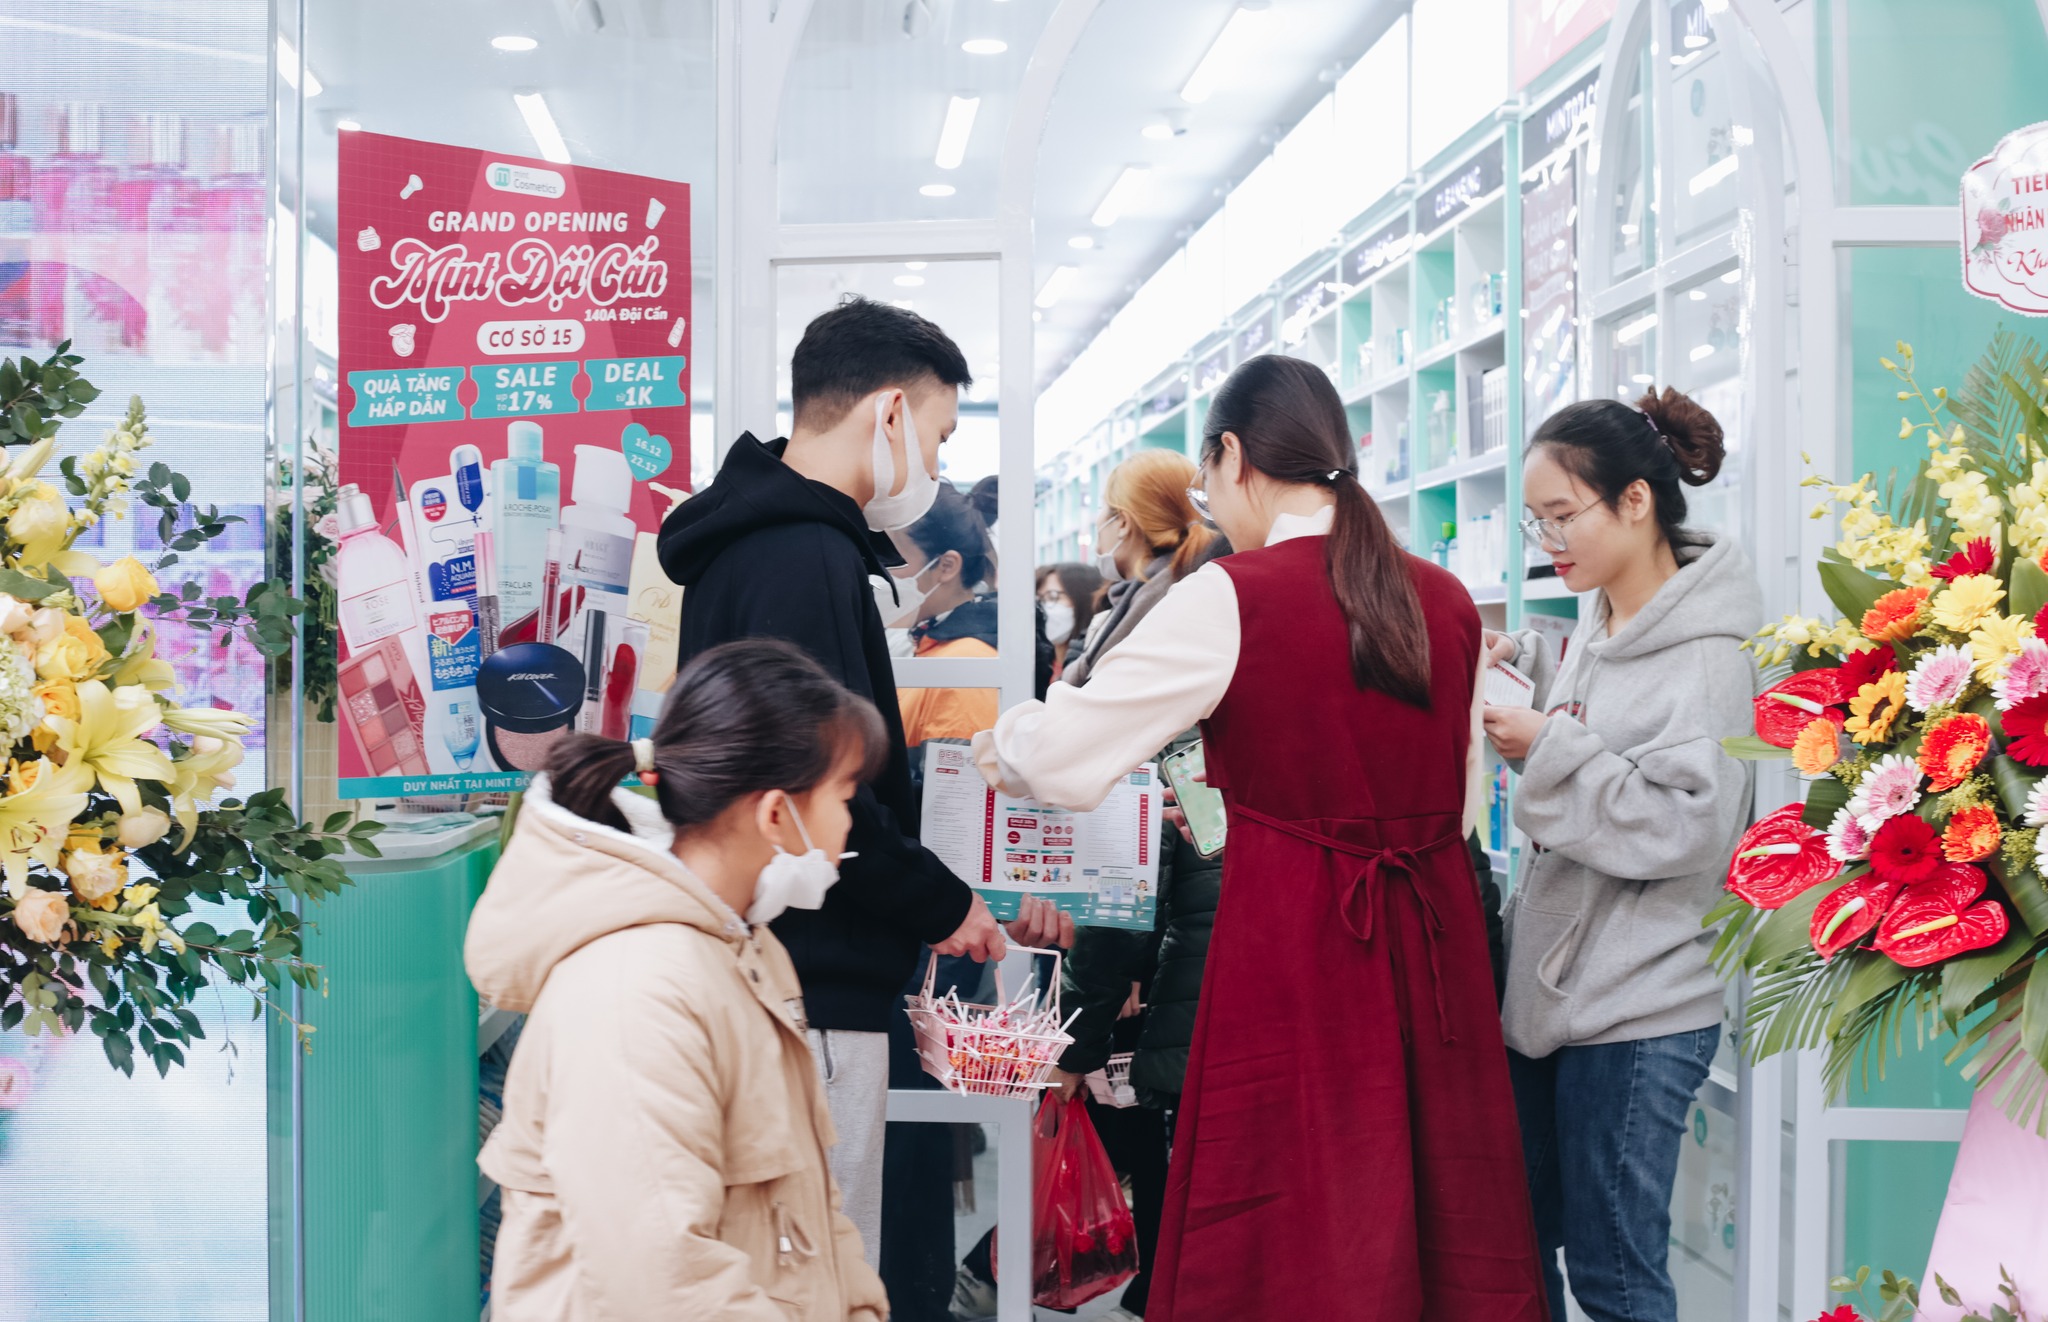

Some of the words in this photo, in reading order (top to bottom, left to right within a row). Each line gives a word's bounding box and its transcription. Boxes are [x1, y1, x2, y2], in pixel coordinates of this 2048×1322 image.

[513, 178, 557, 194] Cosmetics
[428, 211, 516, 232] GRAND
[524, 212, 628, 233] OPENING
[370, 238, 501, 323] Mint
[495, 238, 593, 312] Đội
[587, 235, 668, 306] Cấn
[584, 309, 617, 322] 140A
[618, 307, 642, 324] Đội
[644, 306, 668, 320] Cấn
[489, 328, 515, 347] CƠ
[520, 325, 546, 346] SỞ
[552, 329, 572, 345] 15
[495, 366, 557, 388] SALE
[604, 361, 664, 383] DEAL
[363, 374, 402, 398] QUÀ
[406, 373, 451, 396] TẶNG
[625, 386, 653, 406] 1K
[368, 396, 406, 418] HẤP
[409, 394, 446, 416] DẪN
[507, 390, 553, 412] 17%
[635, 437, 662, 457] 16.12
[630, 454, 657, 474] 22.12
[403, 781, 427, 792] DUY
[430, 776, 461, 790] NHẤT
[464, 779, 484, 790] TẠI
[486, 777, 511, 788] MINT
